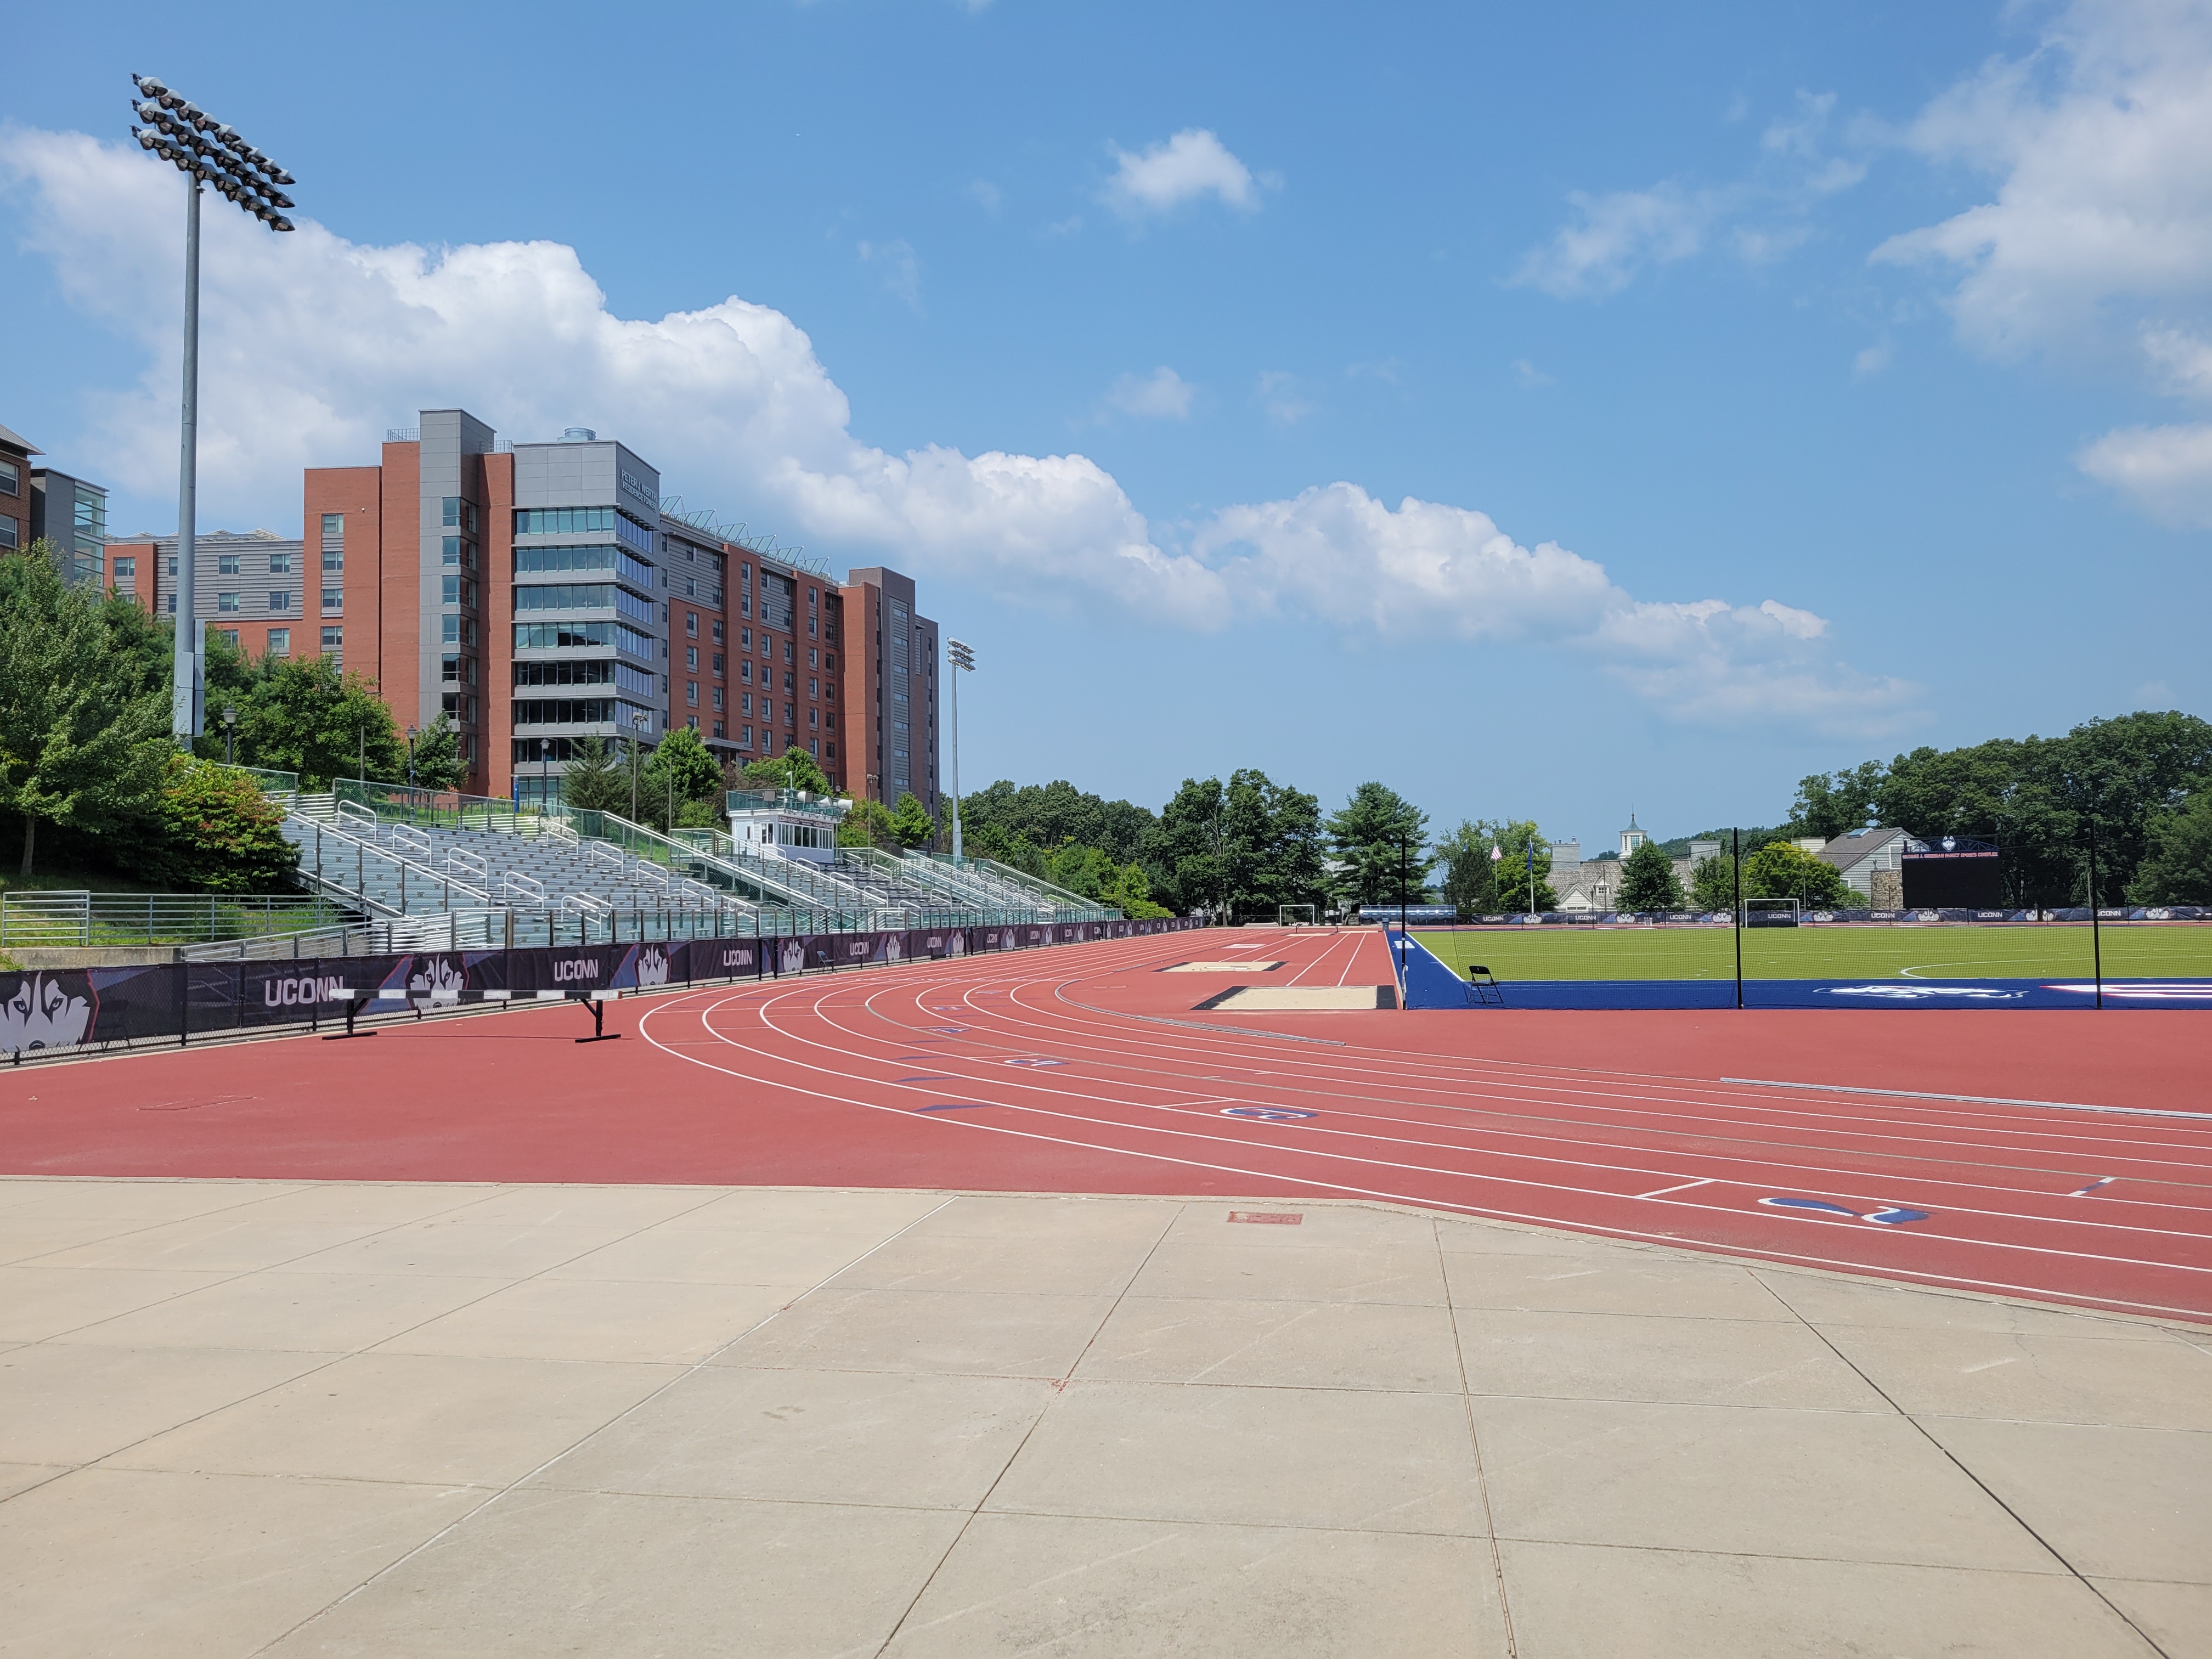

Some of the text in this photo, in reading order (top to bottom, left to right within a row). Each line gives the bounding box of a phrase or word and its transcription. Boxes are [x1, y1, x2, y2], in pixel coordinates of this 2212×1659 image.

[622, 469, 657, 502] PETER J WERTH
[622, 480, 656, 510] RESIDENCE TOWER
[850, 941, 870, 956] UCONN
[927, 936, 942, 948] UCONN
[554, 958, 599, 981] UCONN
[724, 949, 752, 967] UCONN
[266, 975, 344, 1007] UCONN
